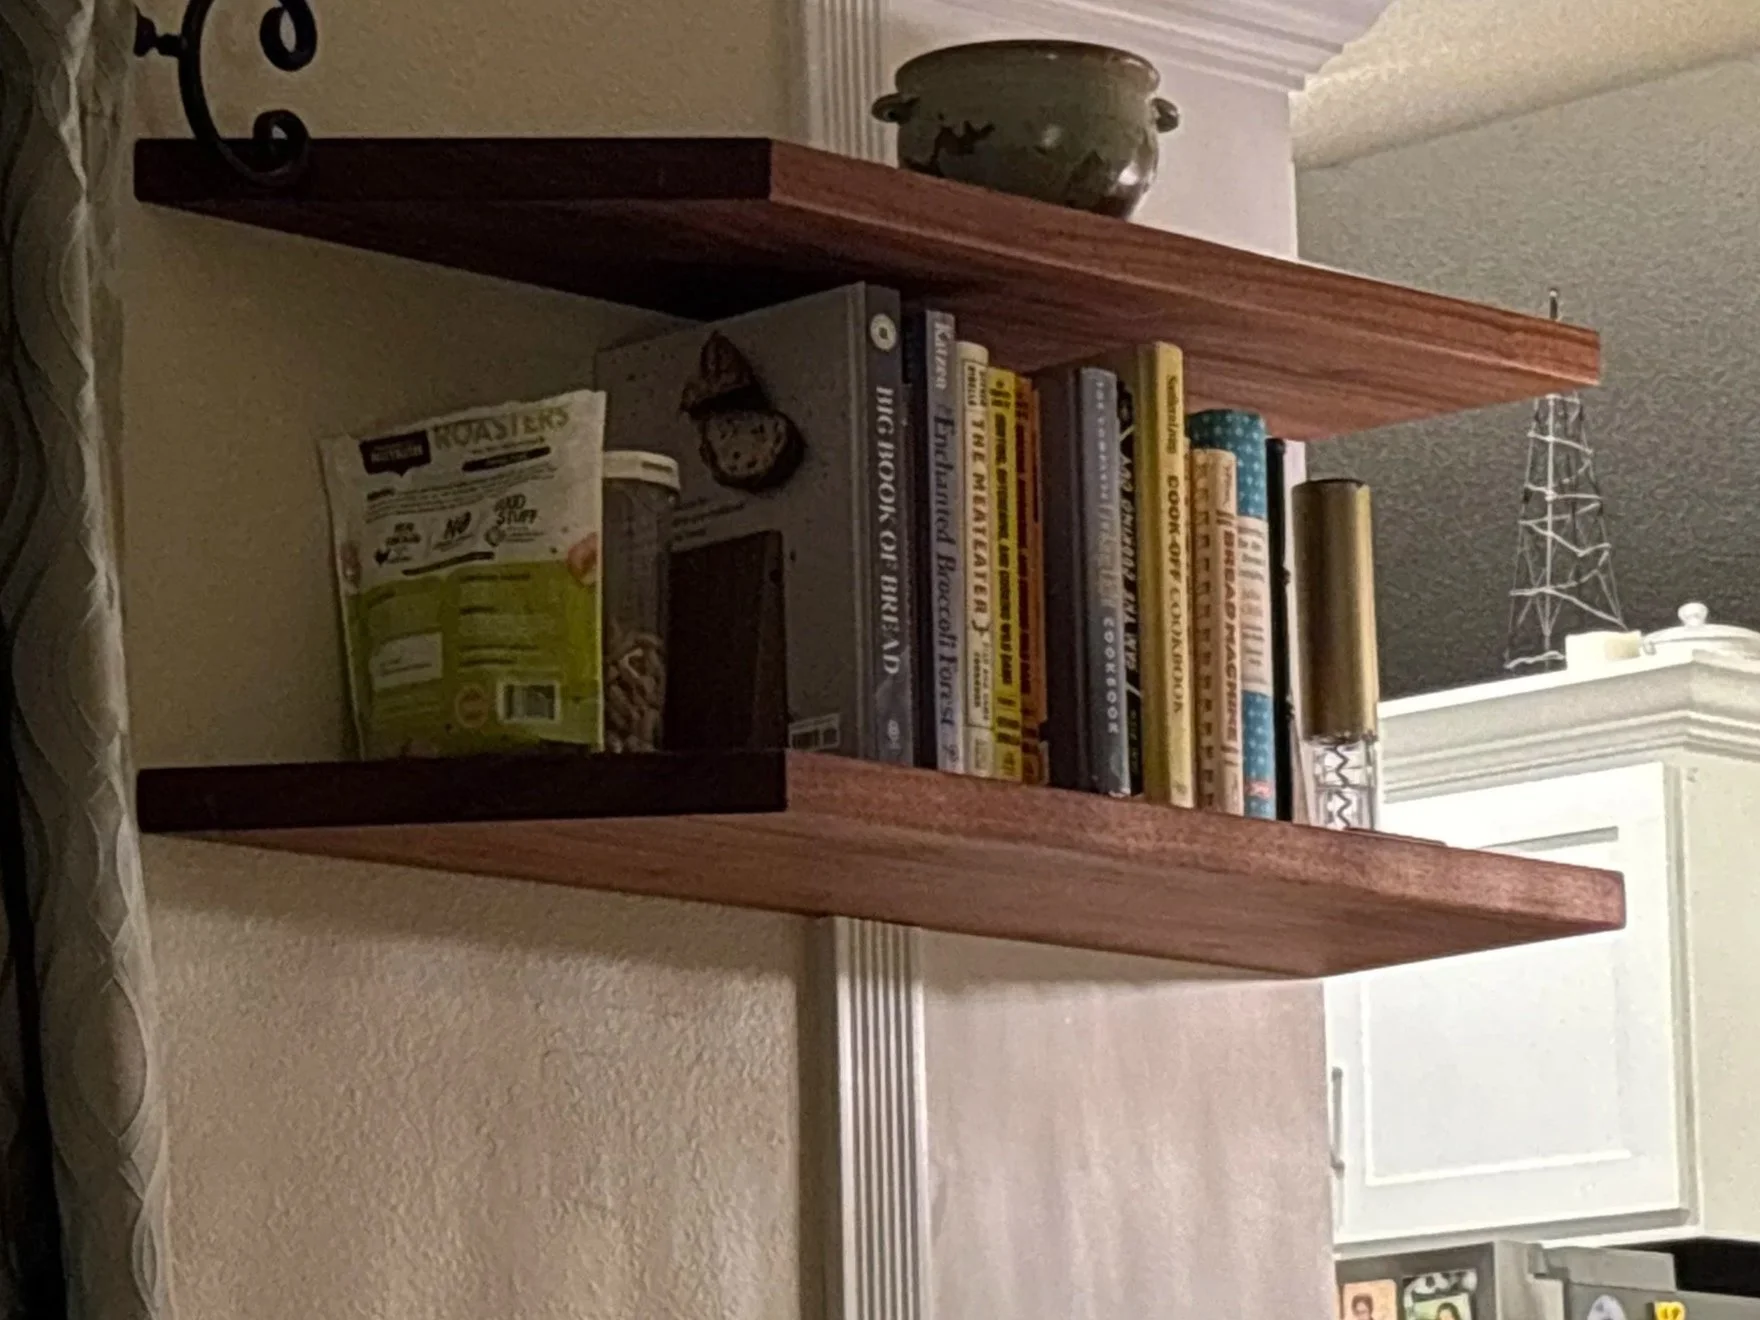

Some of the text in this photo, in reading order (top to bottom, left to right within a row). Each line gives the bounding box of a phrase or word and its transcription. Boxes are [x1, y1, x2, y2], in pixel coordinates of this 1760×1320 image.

[934, 321, 951, 390] Katzen
[1166, 374, 1179, 422] Southern
[431, 408, 571, 450] ROASTERS
[934, 415, 958, 543] Enchanted
[876, 387, 902, 675] BIG BOOK OF BREAD
[972, 419, 989, 615] THE MEATEATER
[936, 553, 958, 649] Broccoli
[1167, 474, 1184, 713] COOK-OFF COOKBOOK
[1223, 529, 1239, 742] BREAD MACHINE
[938, 653, 960, 727] Forest
[1105, 617, 1119, 734] COOKBOOK
